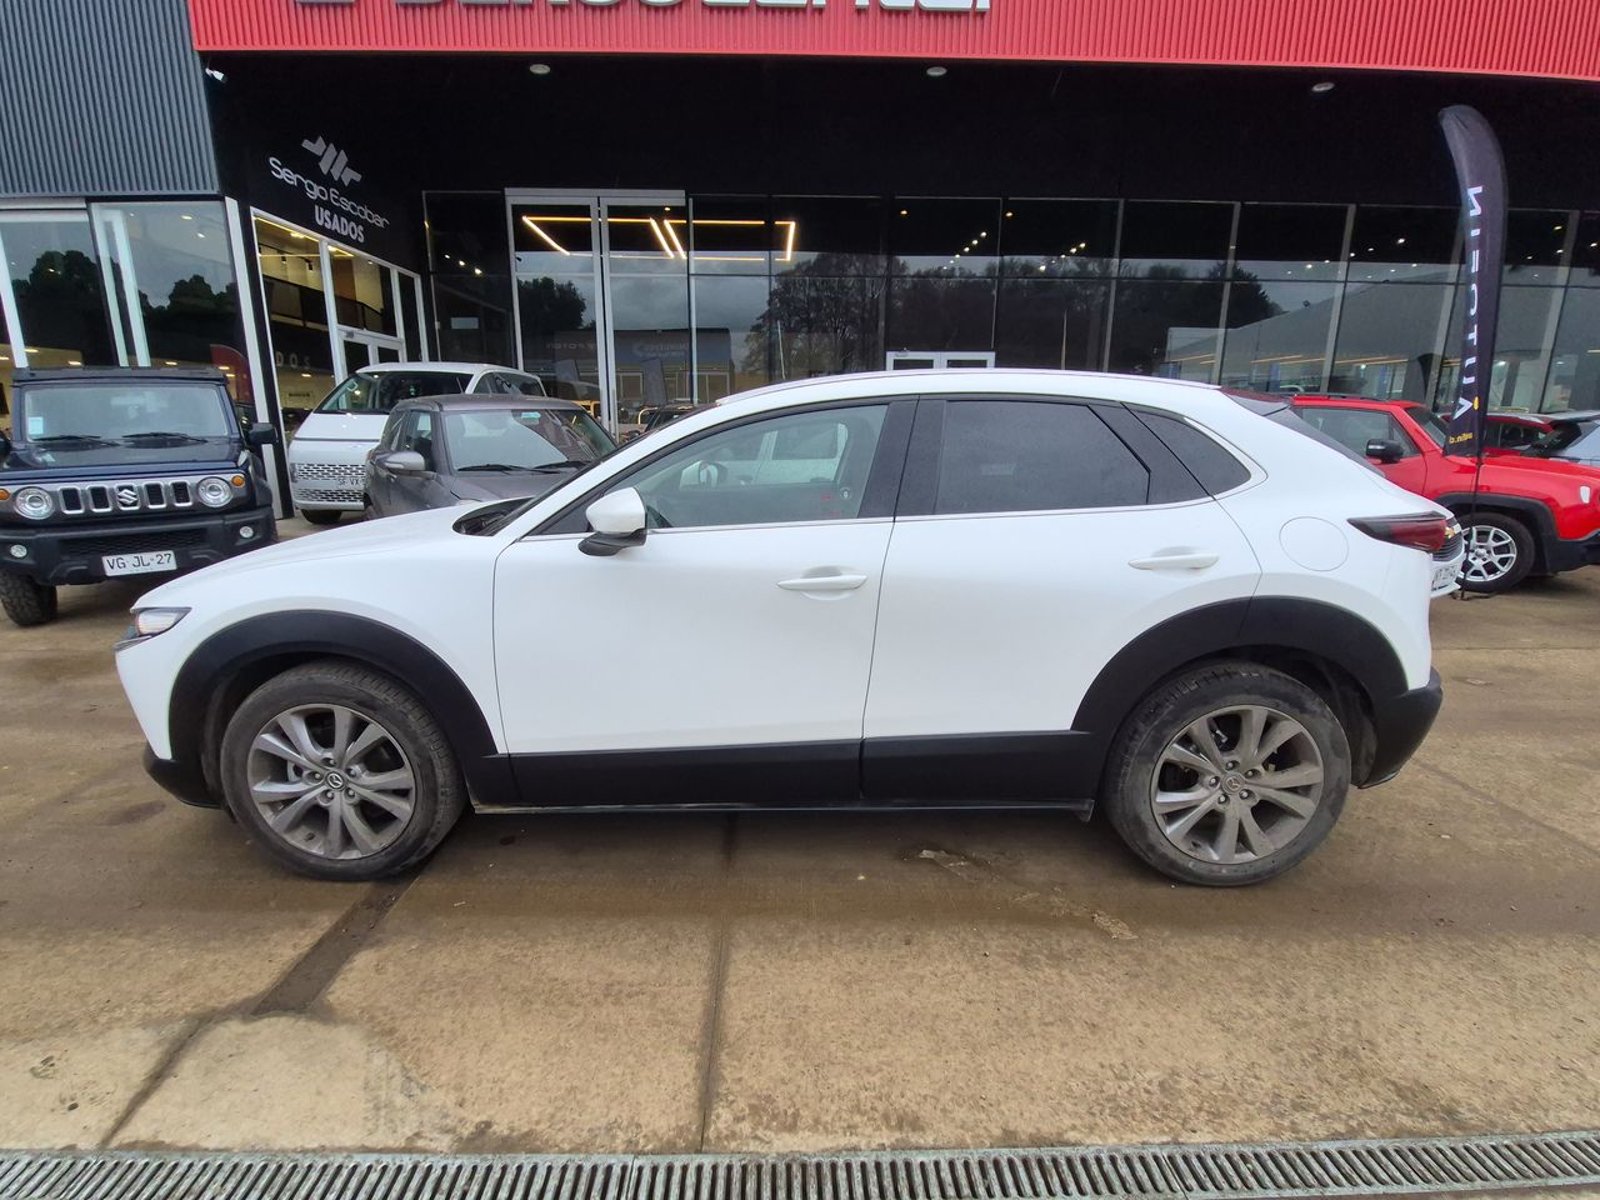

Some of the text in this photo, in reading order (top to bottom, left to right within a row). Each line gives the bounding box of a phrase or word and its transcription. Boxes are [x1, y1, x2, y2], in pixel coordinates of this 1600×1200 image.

[314, 204, 365, 243] USADOS
[329, 187, 390, 229] Escobar
[106, 557, 126, 570] VG
